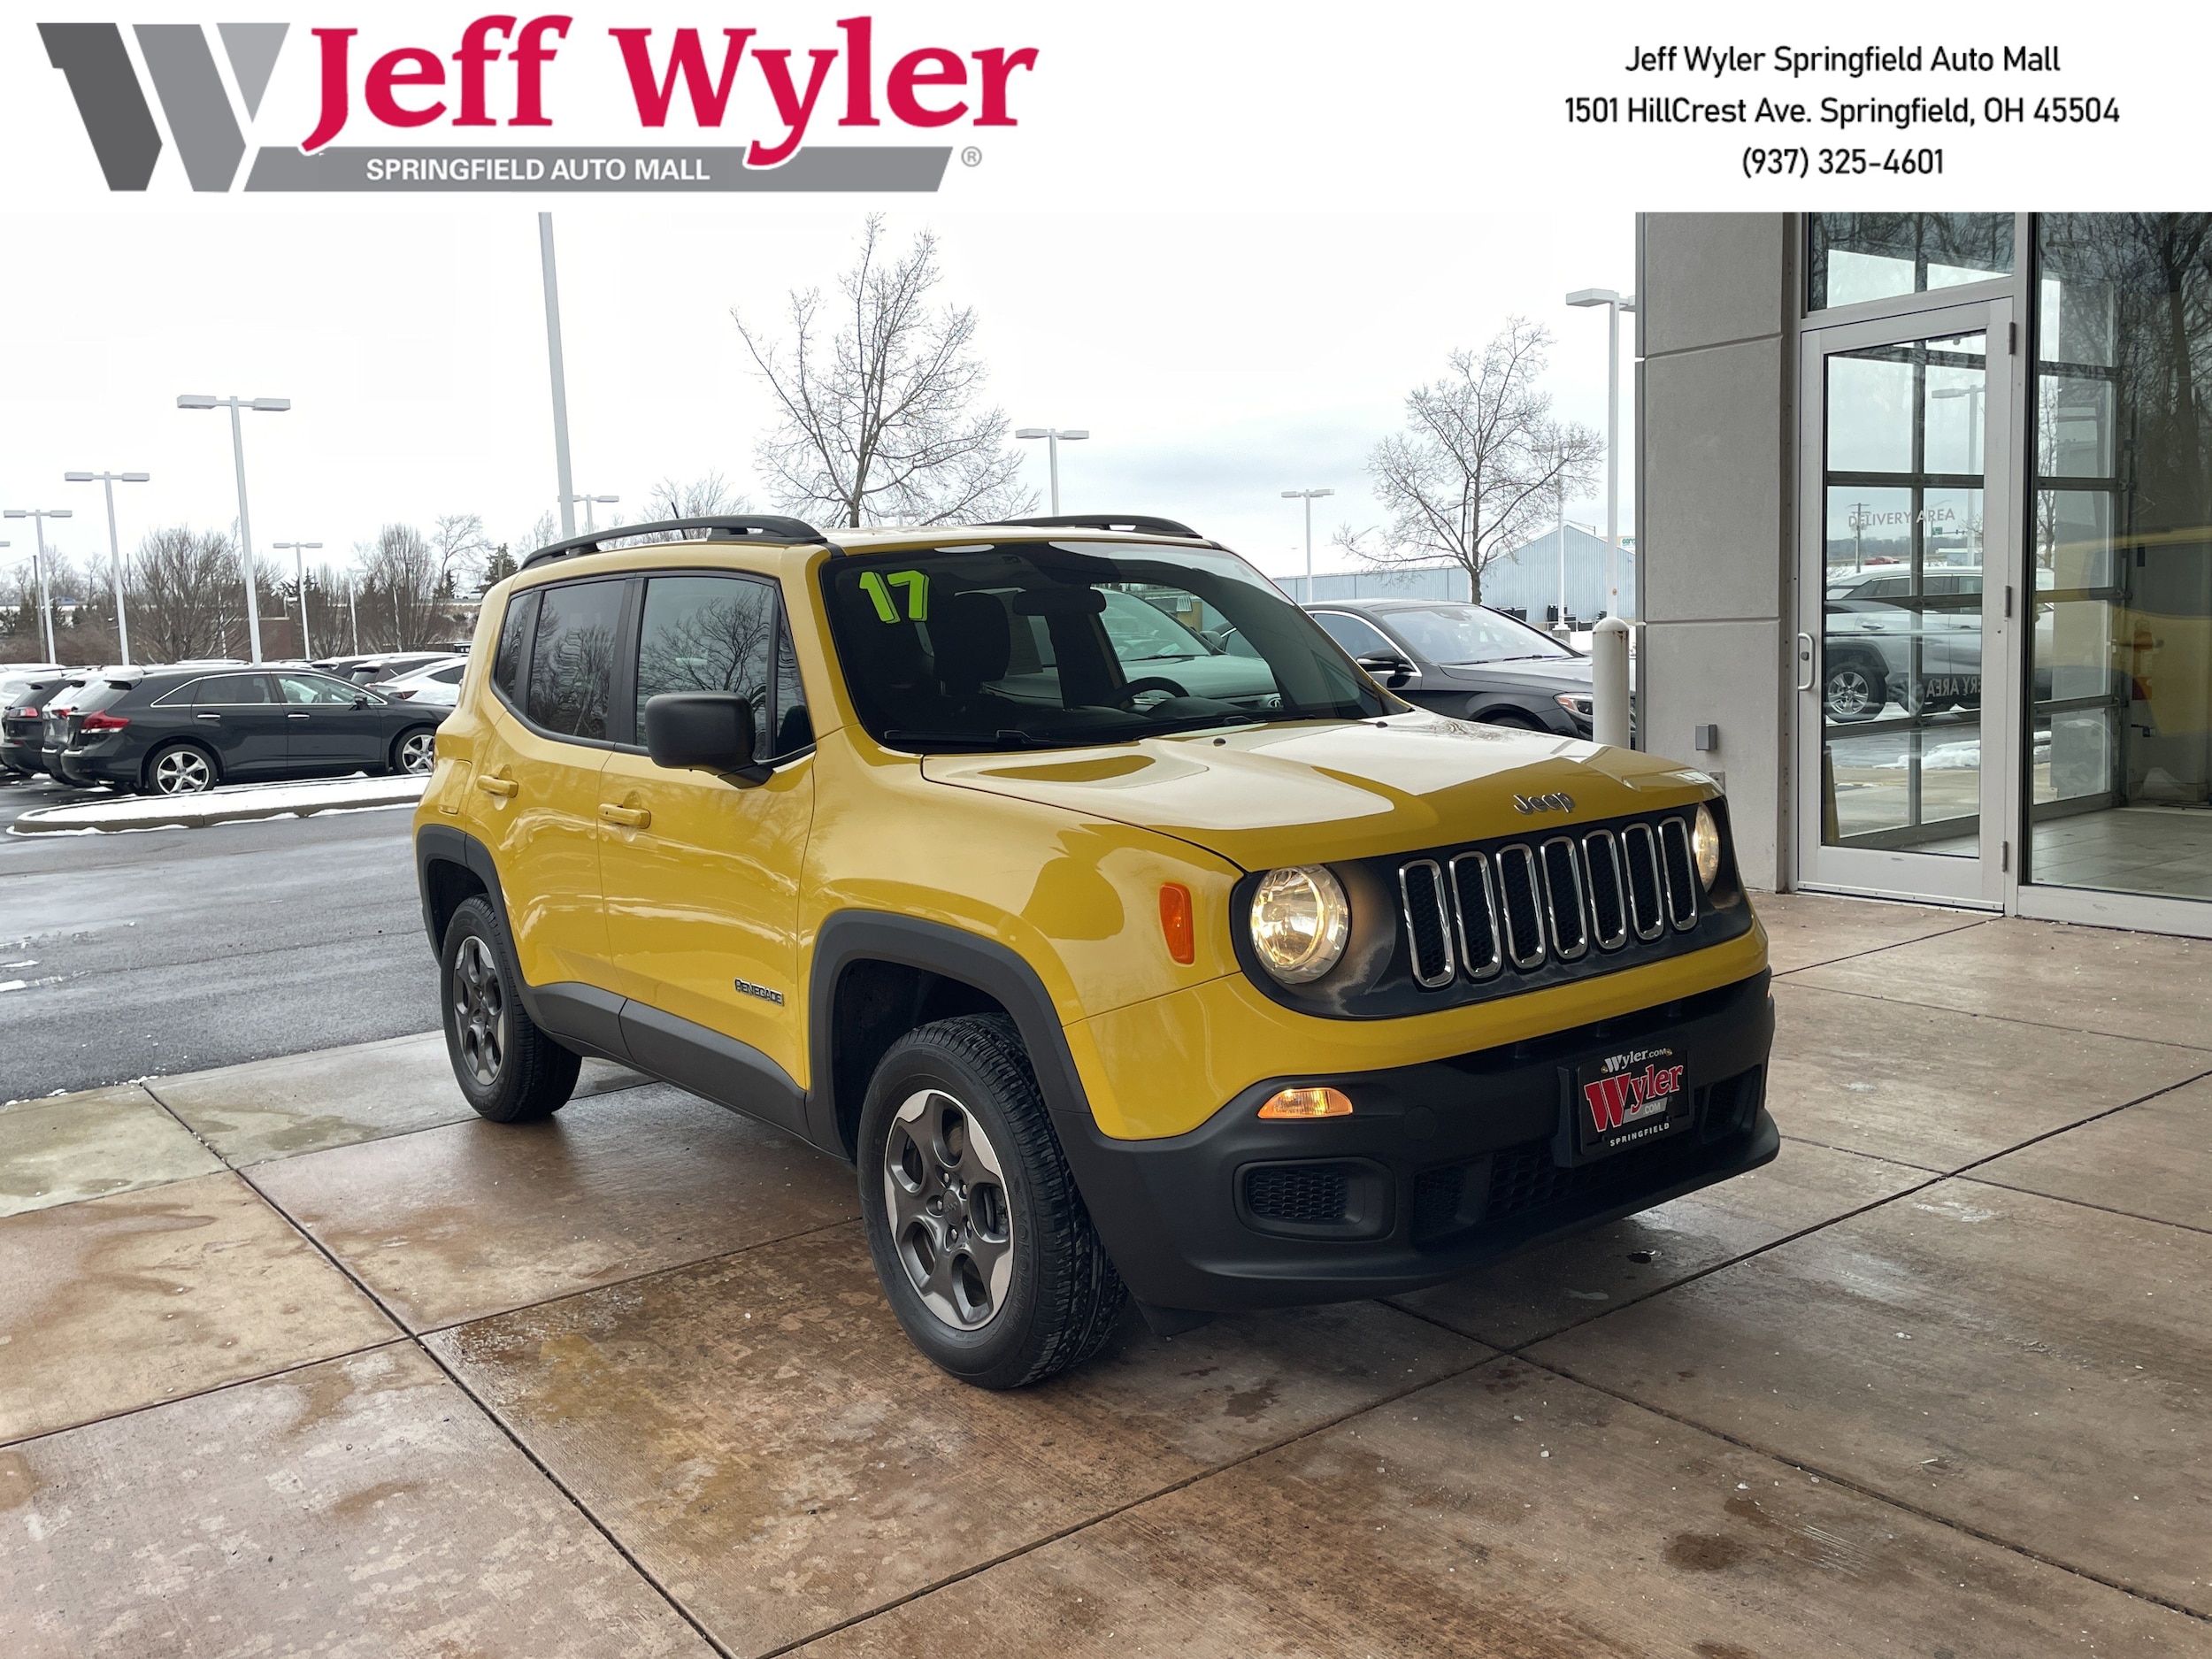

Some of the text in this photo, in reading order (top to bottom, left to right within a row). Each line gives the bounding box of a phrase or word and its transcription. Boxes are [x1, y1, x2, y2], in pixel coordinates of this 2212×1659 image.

[1848, 508, 1955, 527] DELIVERY AREA
[859, 570, 929, 624] 17
[1513, 792, 1575, 815] Jeep
[733, 977, 785, 1007] RENEGADE
[1584, 1064, 1684, 1133] Wyler
[1609, 1122, 1671, 1147] SPRINGFIELD
